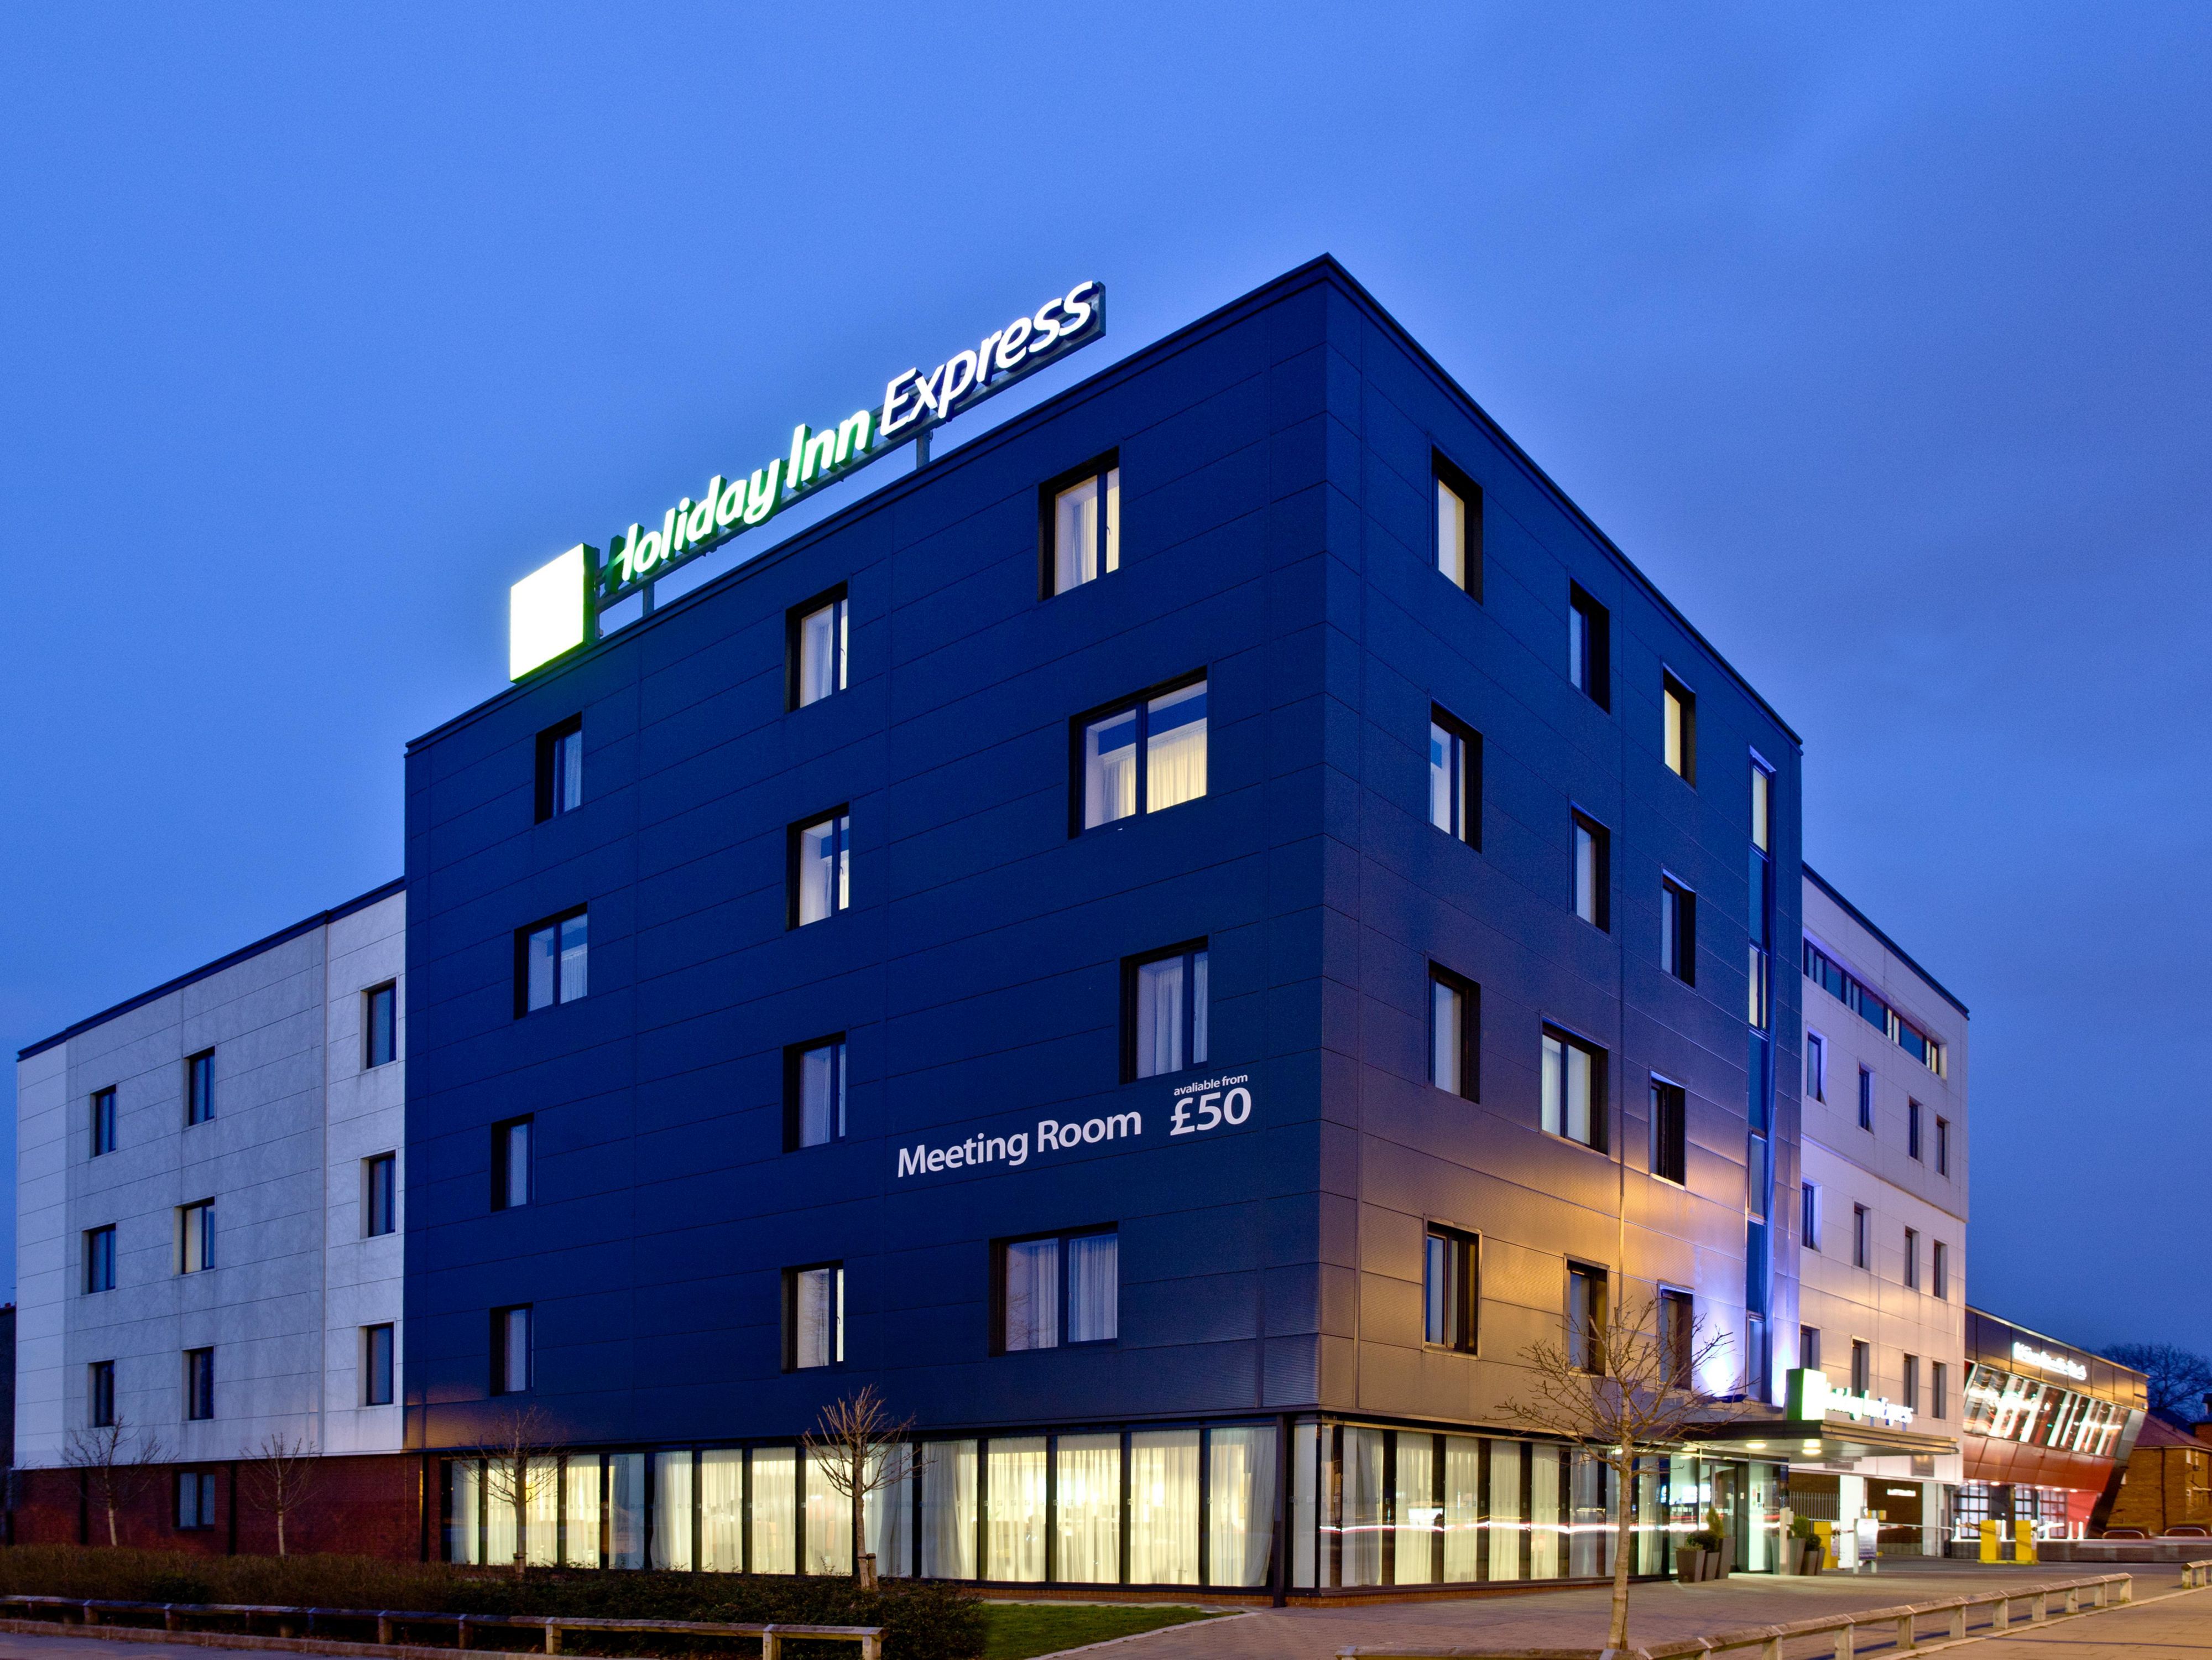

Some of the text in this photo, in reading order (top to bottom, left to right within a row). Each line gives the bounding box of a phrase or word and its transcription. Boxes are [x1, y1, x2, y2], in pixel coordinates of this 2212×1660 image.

[604, 280, 1094, 592] Holiday Inn Express
[1170, 1087, 1251, 1136] £50
[1173, 1074, 1248, 1096] avaliable from
[898, 1111, 1141, 1178] Meeting Room
